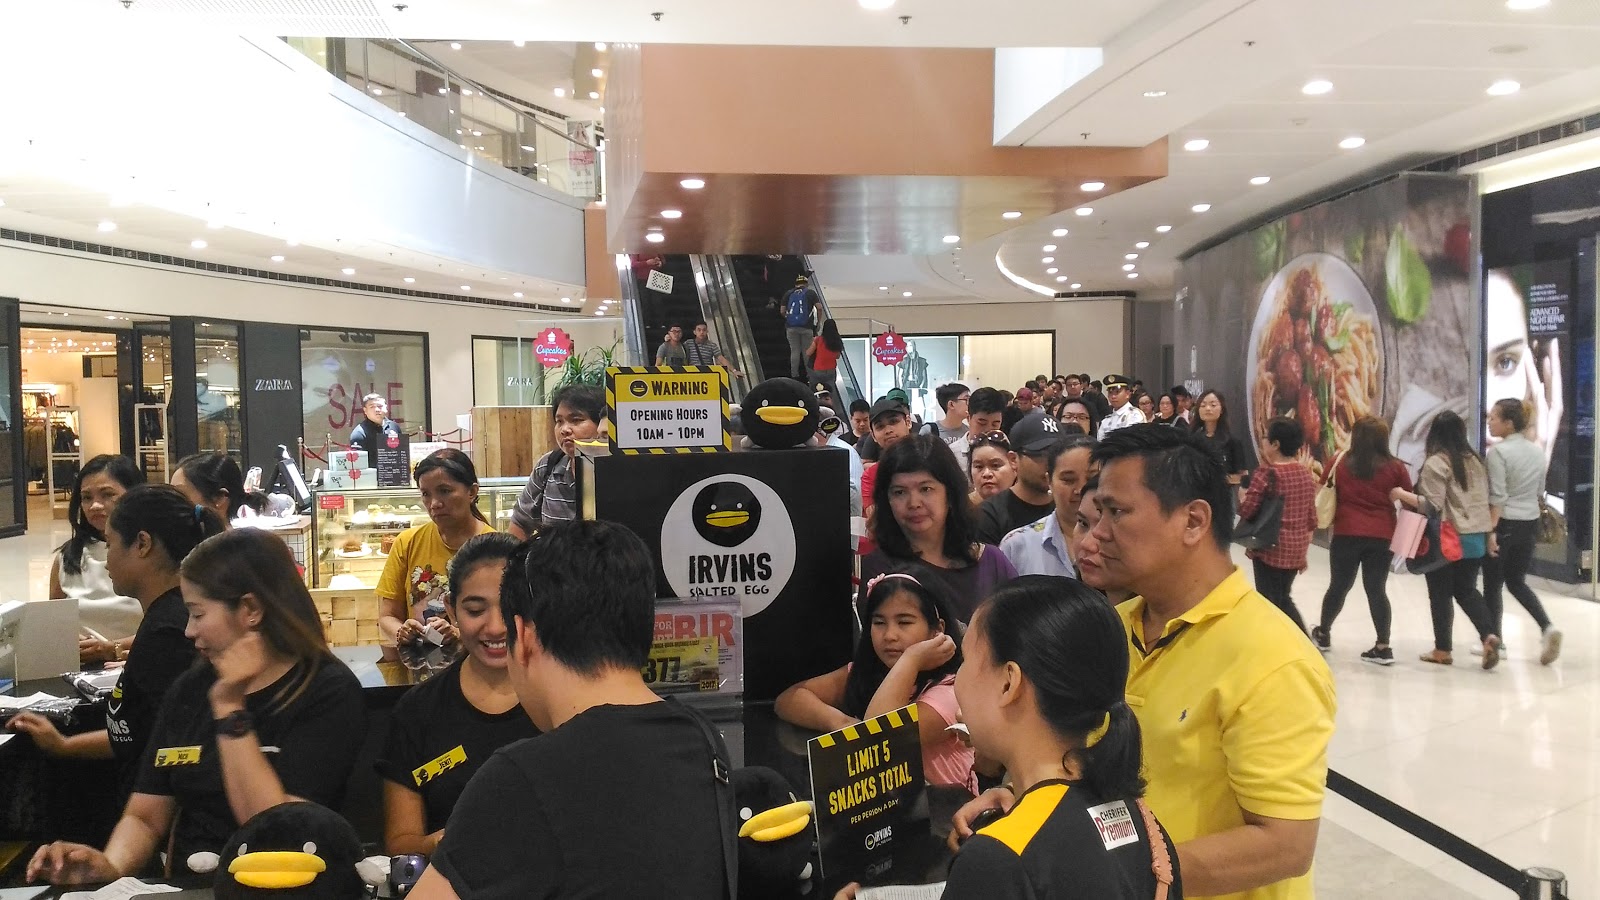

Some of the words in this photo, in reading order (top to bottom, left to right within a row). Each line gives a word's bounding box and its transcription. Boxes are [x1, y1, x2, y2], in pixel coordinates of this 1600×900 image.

[1530, 306, 1560, 316] ADVANCED
[1530, 316, 1546, 324] NIGHT
[1547, 314, 1565, 323] REPAIR
[536, 344, 567, 356] Cupcakes
[875, 346, 904, 356] Cupcakes
[255, 378, 293, 391] ZARA
[507, 376, 533, 387] ZARA
[651, 380, 709, 396] WARNING
[328, 382, 405, 430] SAE
[630, 409, 673, 421] OPENING
[676, 408, 708, 420] HOURS
[1041, 417, 1059, 433] NY
[636, 428, 664, 440] 10AM
[678, 427, 705, 439] 10PM
[689, 552, 772, 584] IRVINS
[690, 586, 736, 598] SALTED
[744, 585, 769, 595] EGG
[674, 612, 735, 647] BIR
[701, 680, 716, 689] 2017
[846, 743, 880, 778] LIMIT
[882, 739, 891, 764] 5
[828, 775, 877, 815] SNACKS
[878, 761, 913, 794] TOTAL
[850, 814, 862, 825] PER
[862, 806, 883, 820] PERSON
[888, 798, 899, 809] DAY
[1100, 806, 1128, 821] CHERIFER
[1094, 816, 1136, 843] Premium
